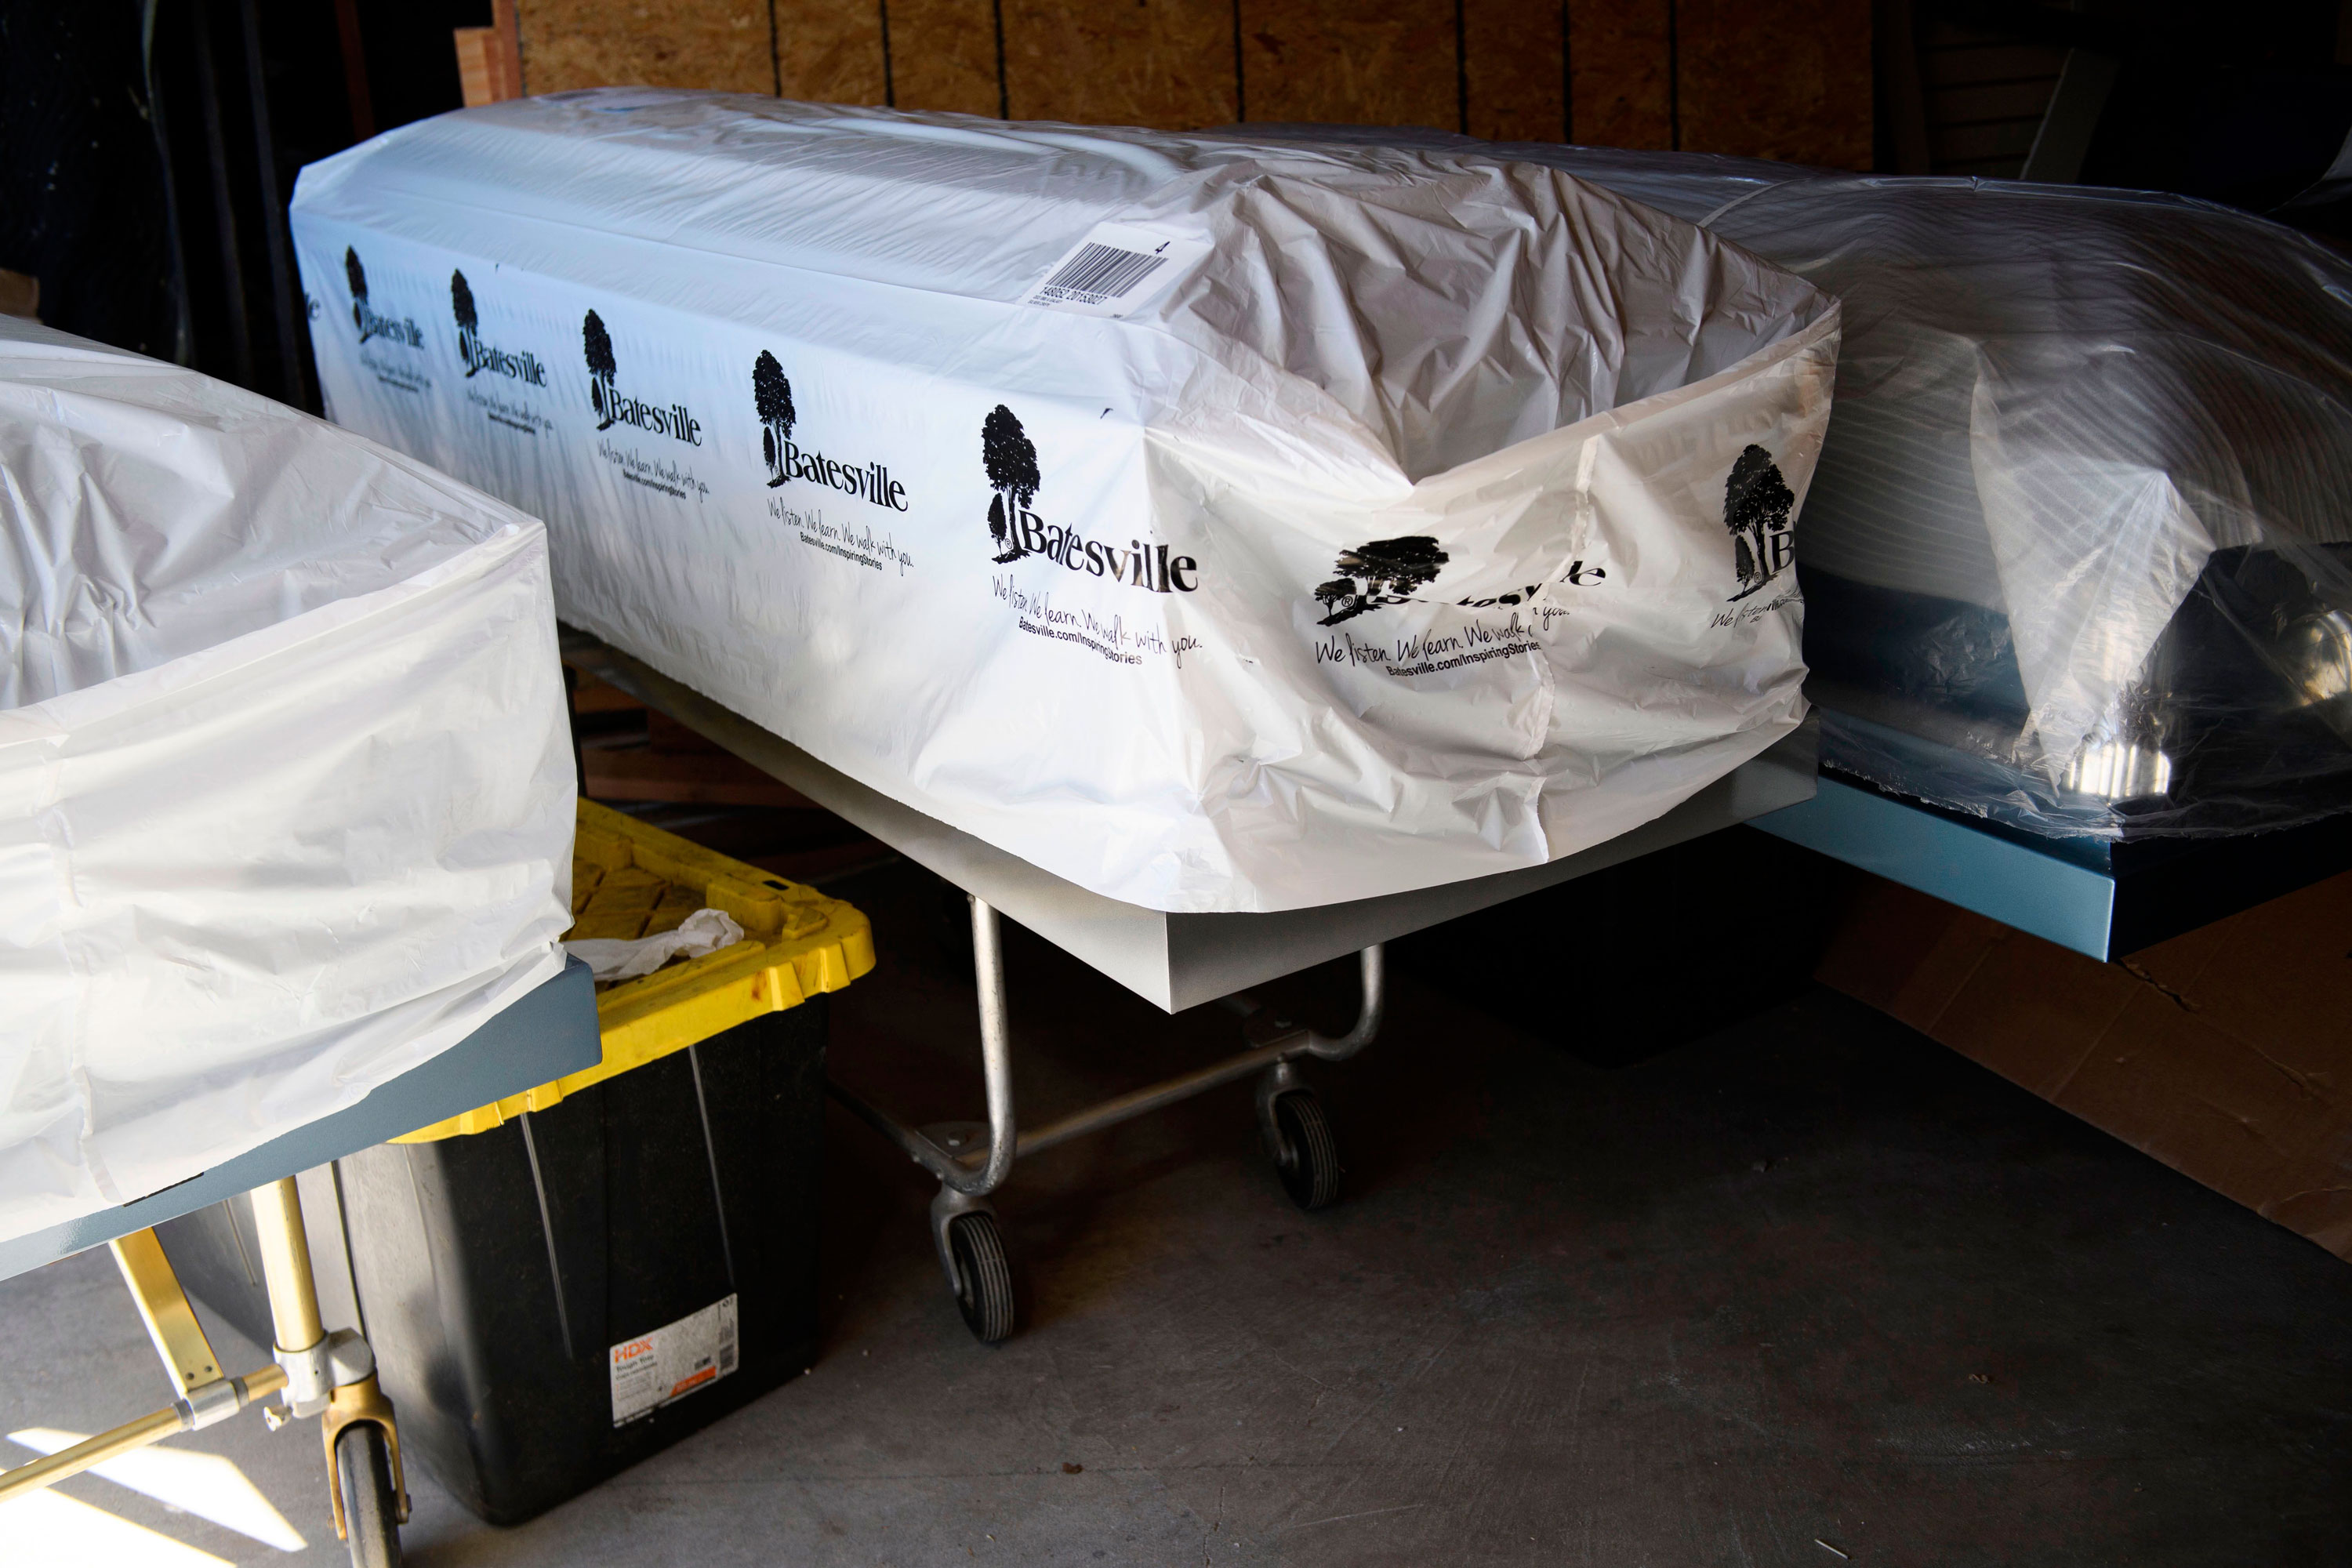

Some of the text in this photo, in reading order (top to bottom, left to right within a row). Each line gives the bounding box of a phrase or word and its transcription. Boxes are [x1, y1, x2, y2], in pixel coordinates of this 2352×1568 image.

[474, 337, 547, 388] Batesville
[608, 387, 702, 446] Batesville
[784, 440, 909, 512] Batesville
[767, 495, 781, 519] We
[804, 509, 818, 533] We
[841, 521, 855, 546] We
[856, 525, 876, 555] walk
[877, 532, 897, 561] with
[897, 550, 914, 577] you.
[800, 532, 883, 571] Batesville.com/InspiringStories
[1018, 509, 1199, 593] Batesville
[992, 573, 1007, 601] We
[1029, 590, 1043, 619] We
[1081, 608, 1099, 636] We
[1101, 614, 1131, 650] walk
[1134, 622, 1167, 655] with
[1171, 634, 1203, 670] you.
[1019, 615, 1143, 665] Batesville.com/InspiringStories
[1316, 634, 1346, 664] We
[1397, 634, 1420, 662] We
[1422, 629, 1464, 661] learn.
[1464, 619, 1493, 647] We
[1491, 612, 1525, 642] walk
[1710, 608, 1734, 629] We
[1385, 641, 1541, 677] Batesville.com/InspiringStories
[615, 1337, 653, 1363] HDX
